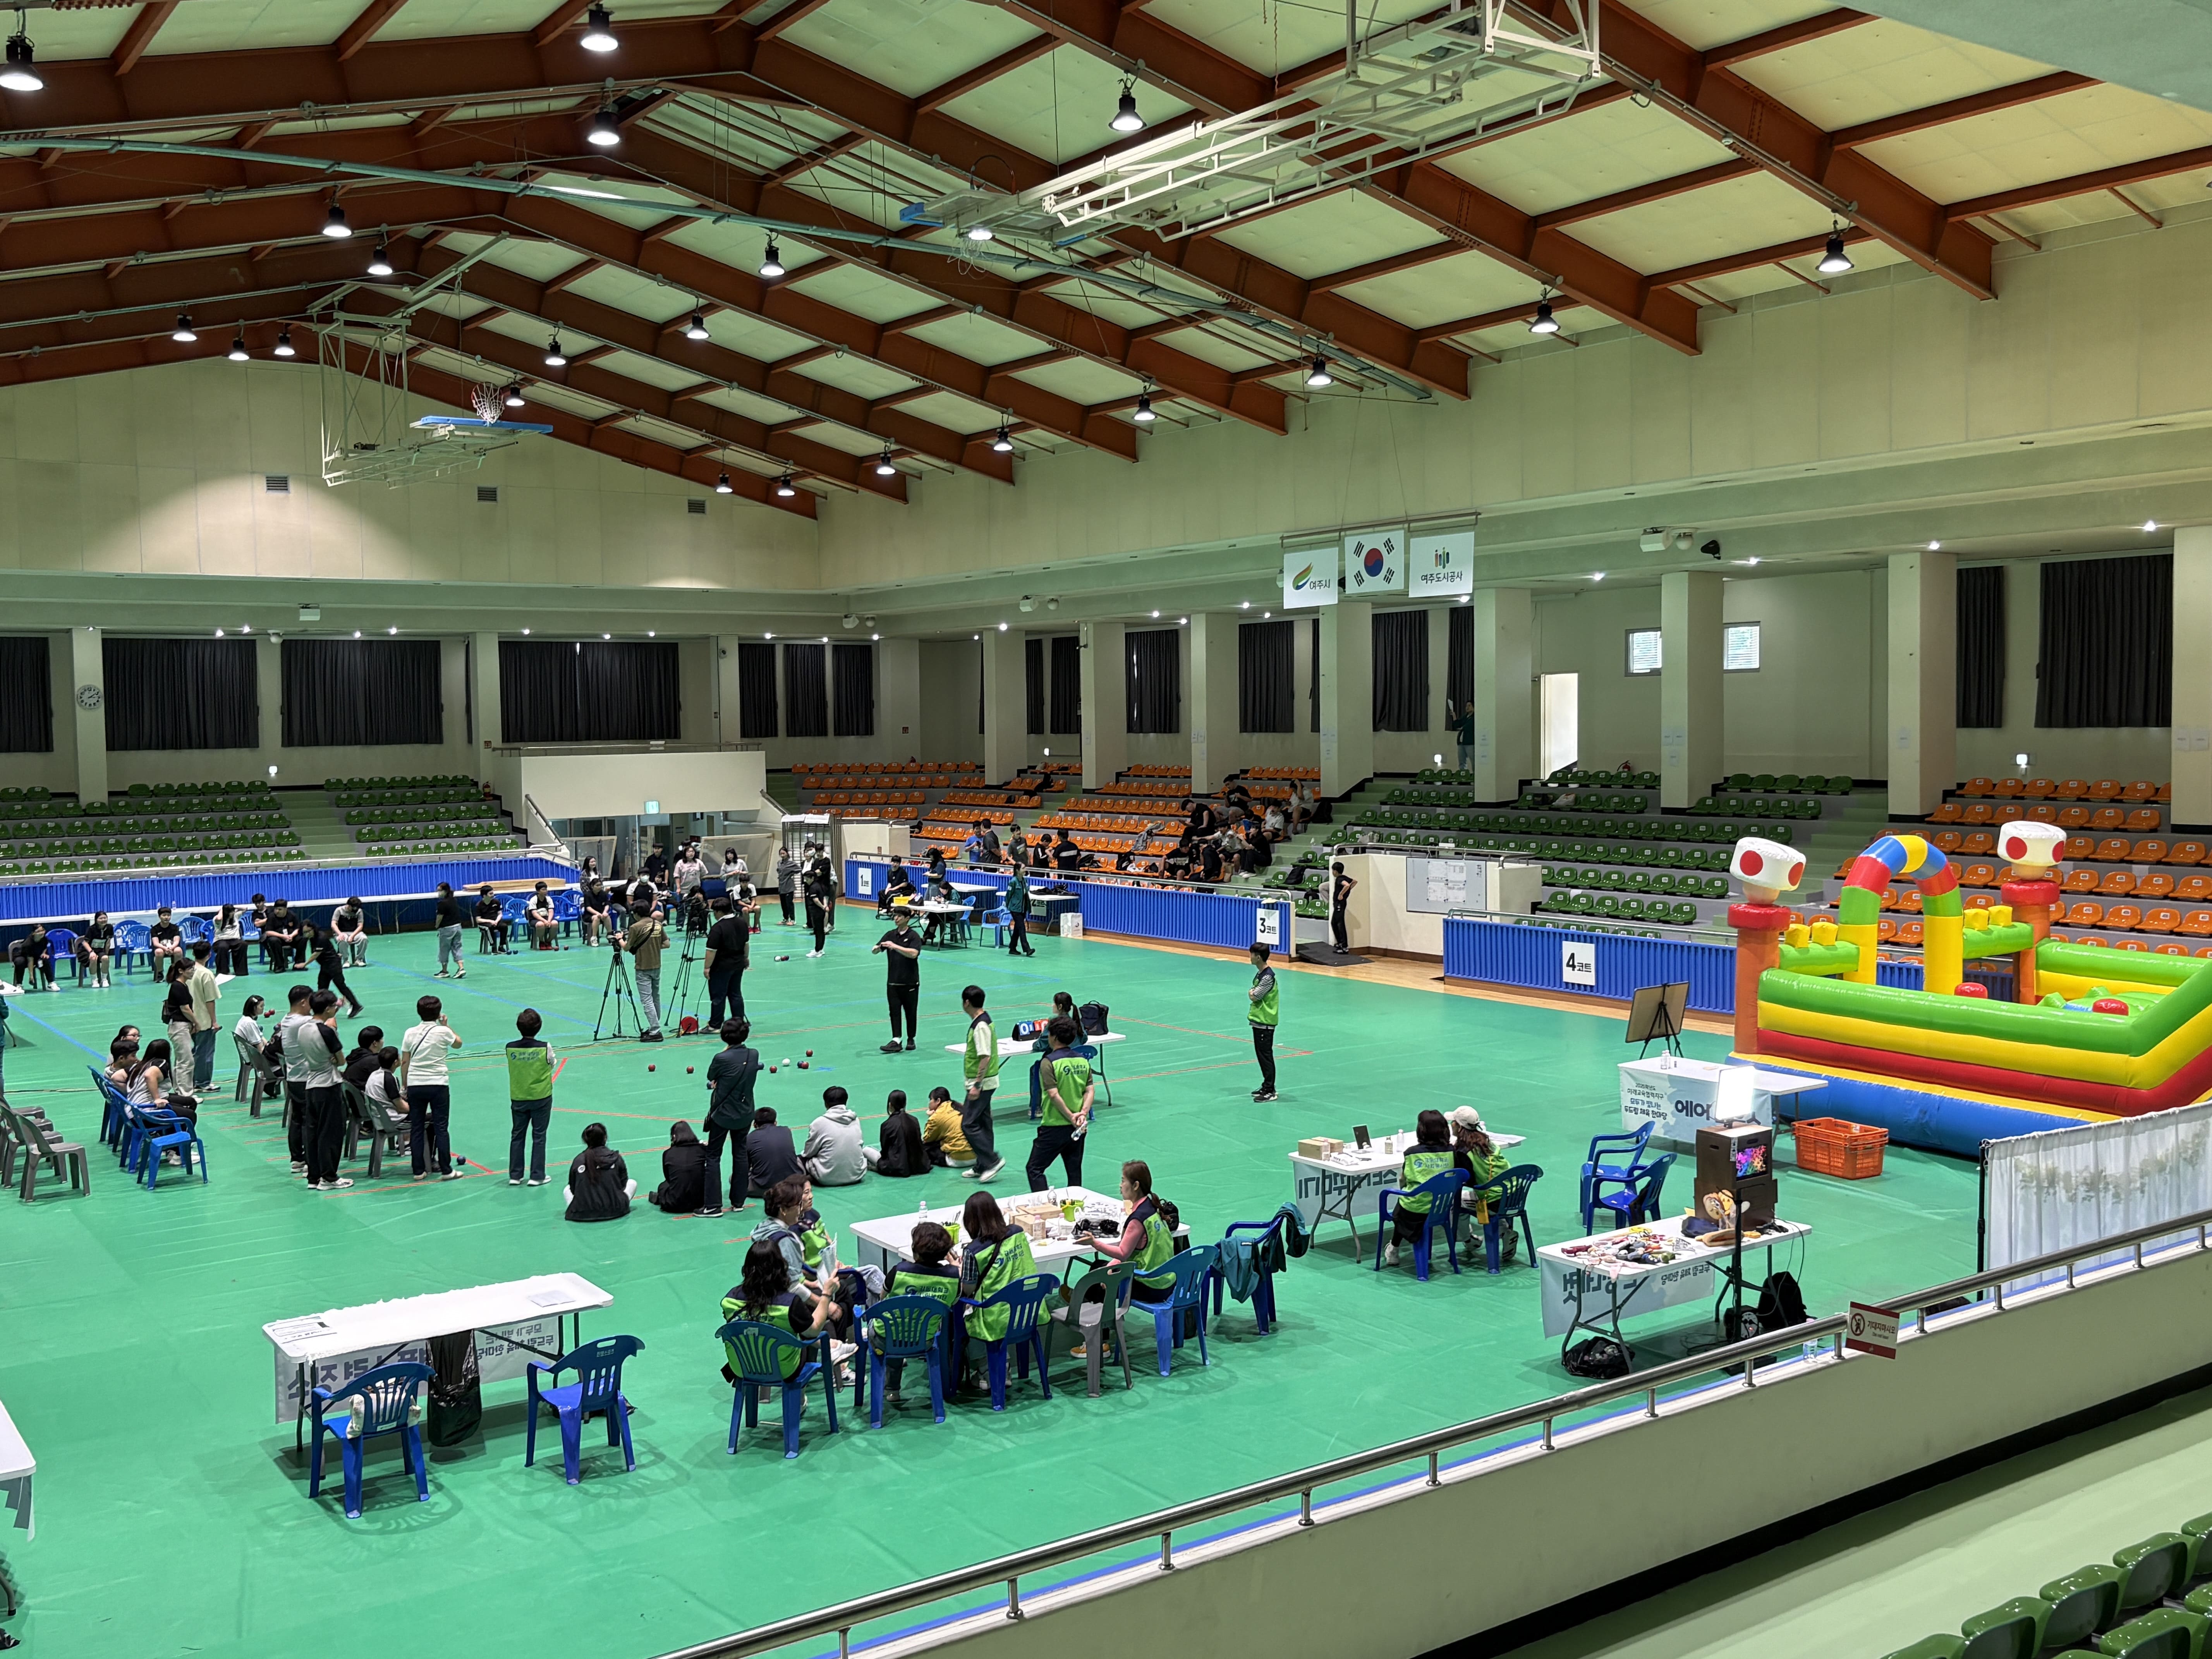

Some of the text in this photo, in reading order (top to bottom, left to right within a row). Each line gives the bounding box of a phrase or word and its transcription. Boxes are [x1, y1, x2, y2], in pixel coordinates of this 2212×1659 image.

[1309, 579, 1331, 590] 여주시
[1421, 570, 1463, 585] 여주도시공사
[1259, 917, 1277, 934] 3코트
[1566, 952, 1592, 973] 4코트
[1624, 1106, 1668, 1120] 두드림 체육 한마당
[1867, 1320, 1896, 1334] 기대지마시오
